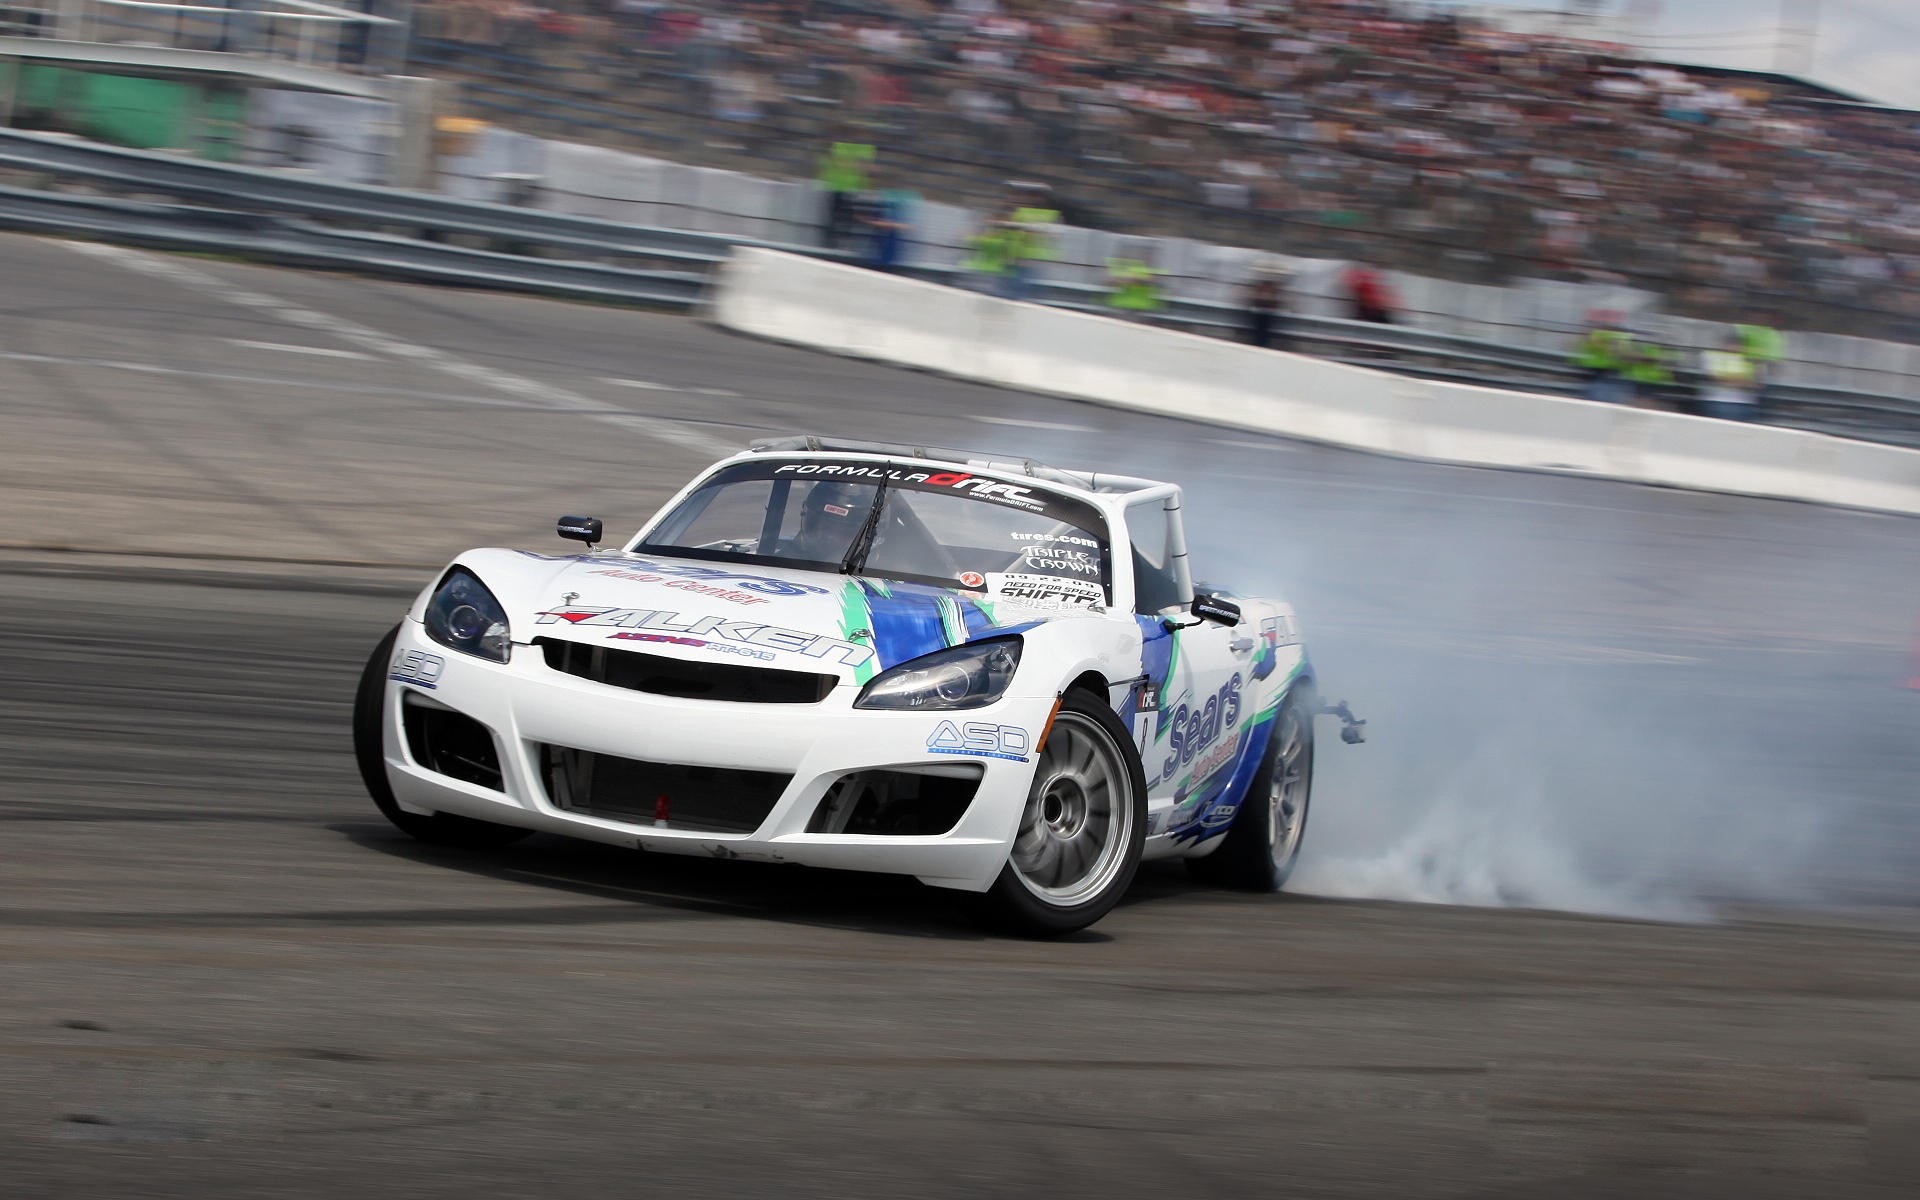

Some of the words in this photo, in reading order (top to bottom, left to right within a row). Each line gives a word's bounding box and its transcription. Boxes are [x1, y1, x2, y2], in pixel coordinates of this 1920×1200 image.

[1010, 531, 1098, 549] tires.com
[1020, 545, 1088, 562] TRIPLE
[1025, 557, 1099, 576] CROWN
[663, 580, 770, 605] Center
[1004, 581, 1037, 589] NEED
[1038, 583, 1062, 592] FOR
[1063, 587, 1101, 598] SPEED
[534, 605, 876, 668] FALKEN
[390, 649, 445, 684] ASD
[926, 719, 1030, 756] ASD
[1162, 671, 1242, 781] Sears
